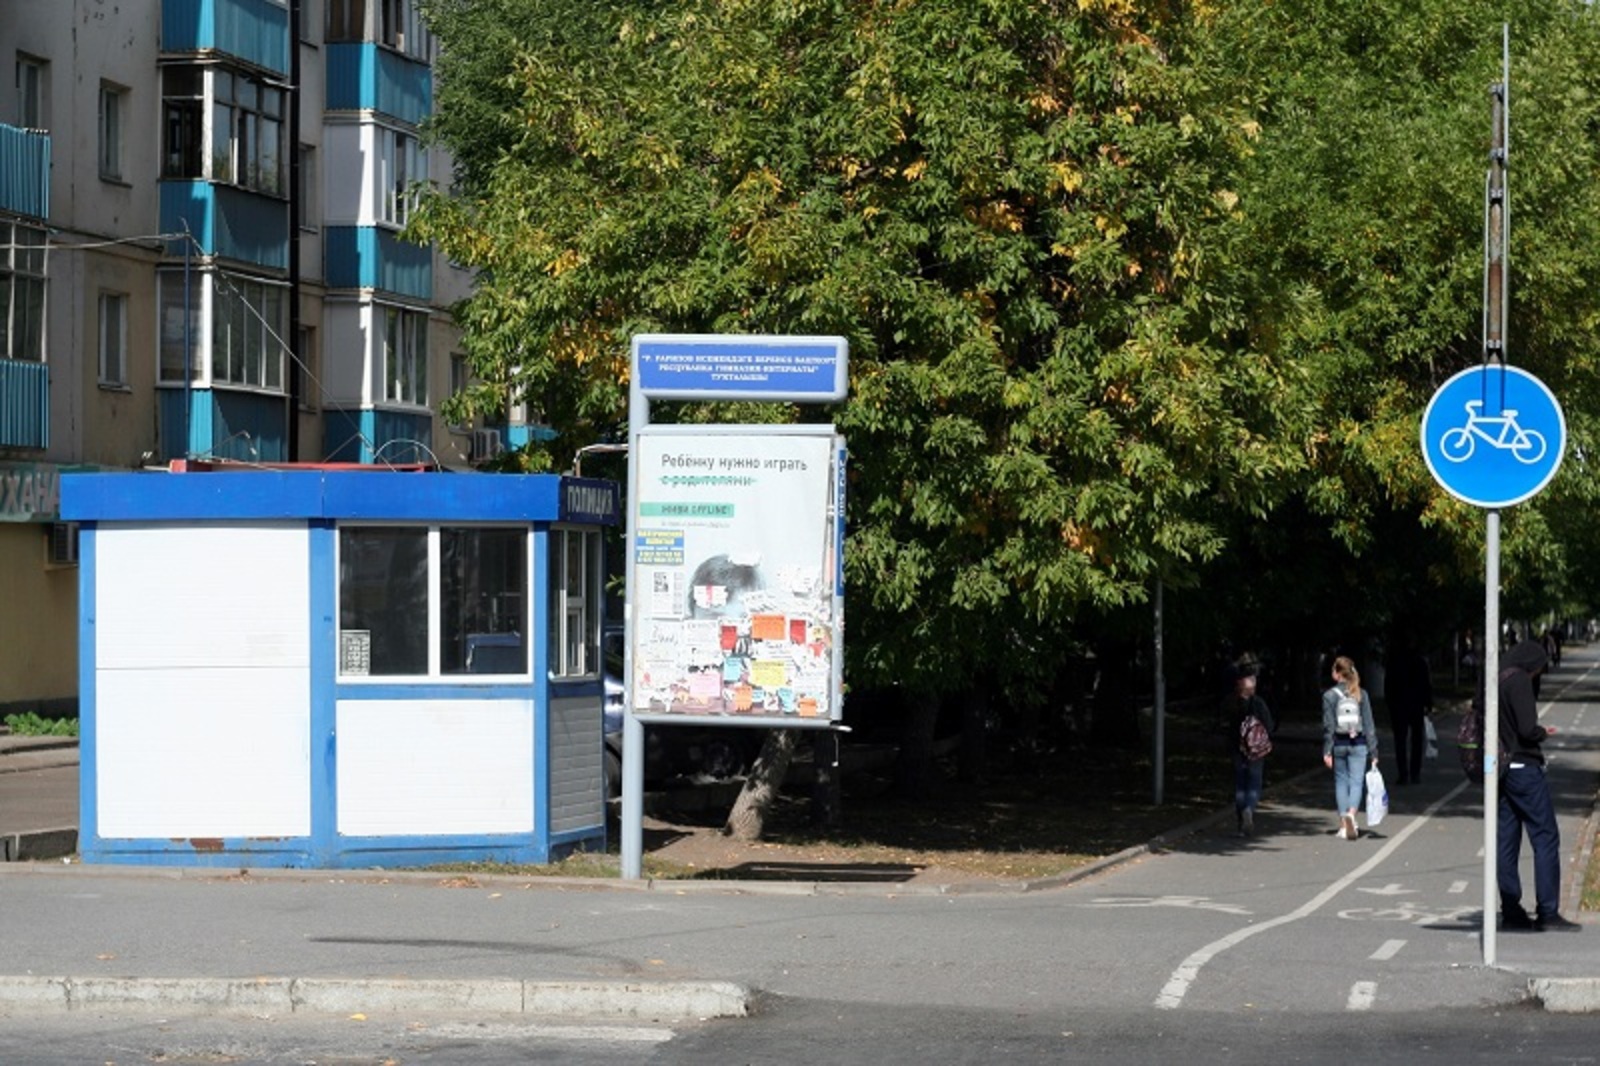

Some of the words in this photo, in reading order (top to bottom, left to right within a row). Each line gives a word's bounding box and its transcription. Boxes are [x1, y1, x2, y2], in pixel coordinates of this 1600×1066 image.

[661, 453, 715, 471] Ребёнку
[719, 456, 761, 471] нужно
[764, 458, 808, 473] играть
[672, 476, 753, 489] родителями
[567, 485, 613, 518] ПОЛИЦИЯ
